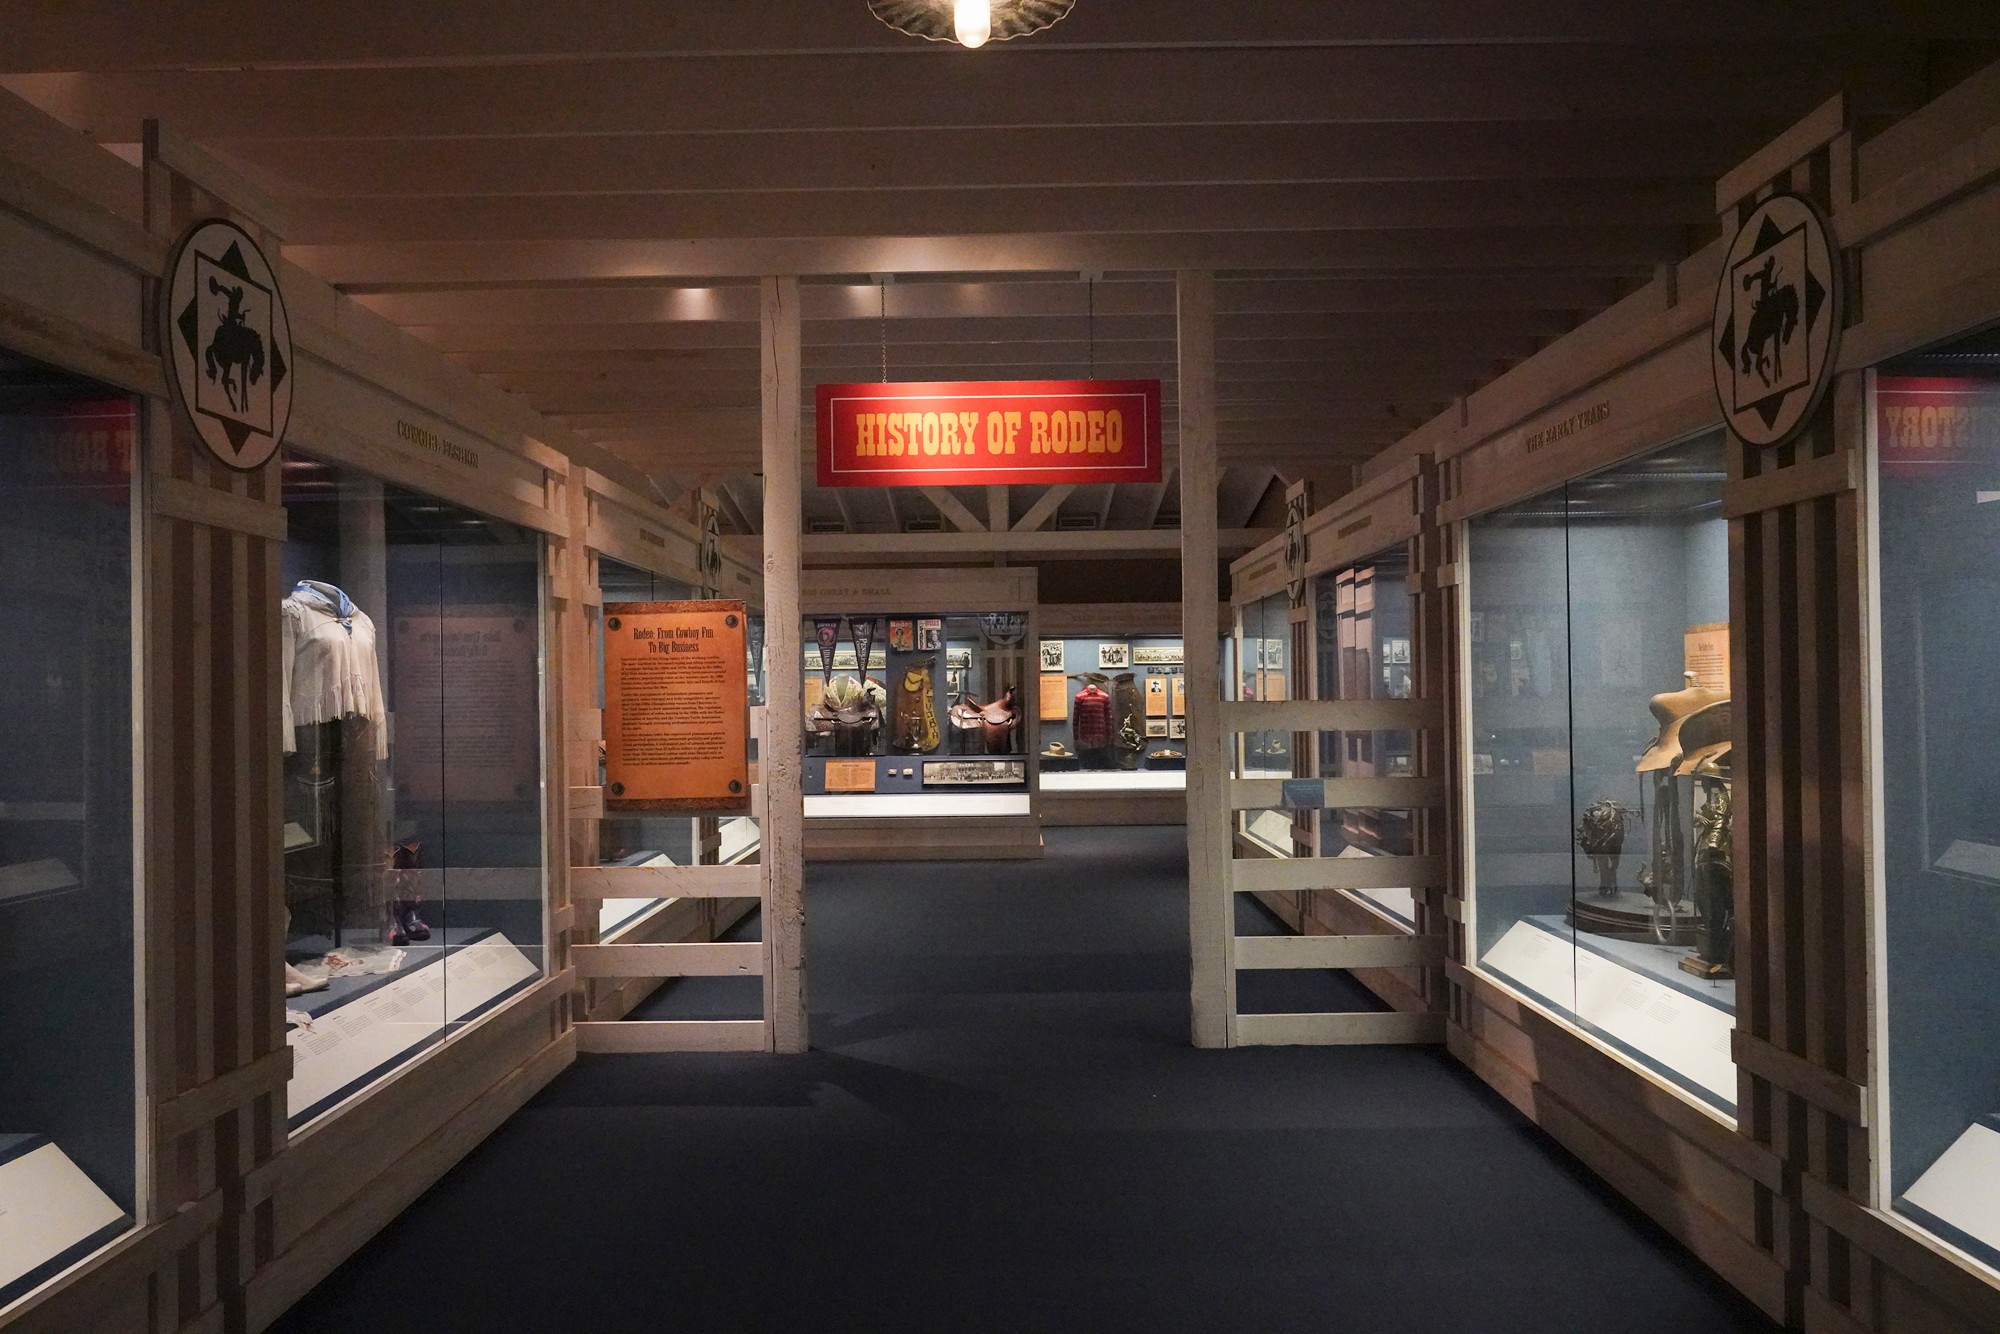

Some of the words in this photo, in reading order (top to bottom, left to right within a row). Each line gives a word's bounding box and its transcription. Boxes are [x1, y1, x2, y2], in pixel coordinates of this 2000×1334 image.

[856, 411, 979, 457] HISTORY
[986, 410, 1022, 455] OF
[1029, 409, 1123, 455] RODEO
[1525, 431, 1544, 454] THE
[1545, 416, 1575, 445] EARLY
[1576, 400, 1610, 430] YEARS
[397, 419, 442, 452] COWGIRL
[442, 439, 479, 469] FASHION
[861, 587, 893, 596] SMALL
[633, 628, 655, 640] Rodeo:
[657, 628, 674, 640] From
[676, 626, 700, 640] Cowboy
[701, 626, 714, 638] Fun
[648, 641, 657, 653] To
[658, 641, 670, 655] Big
[671, 640, 699, 653] Business
